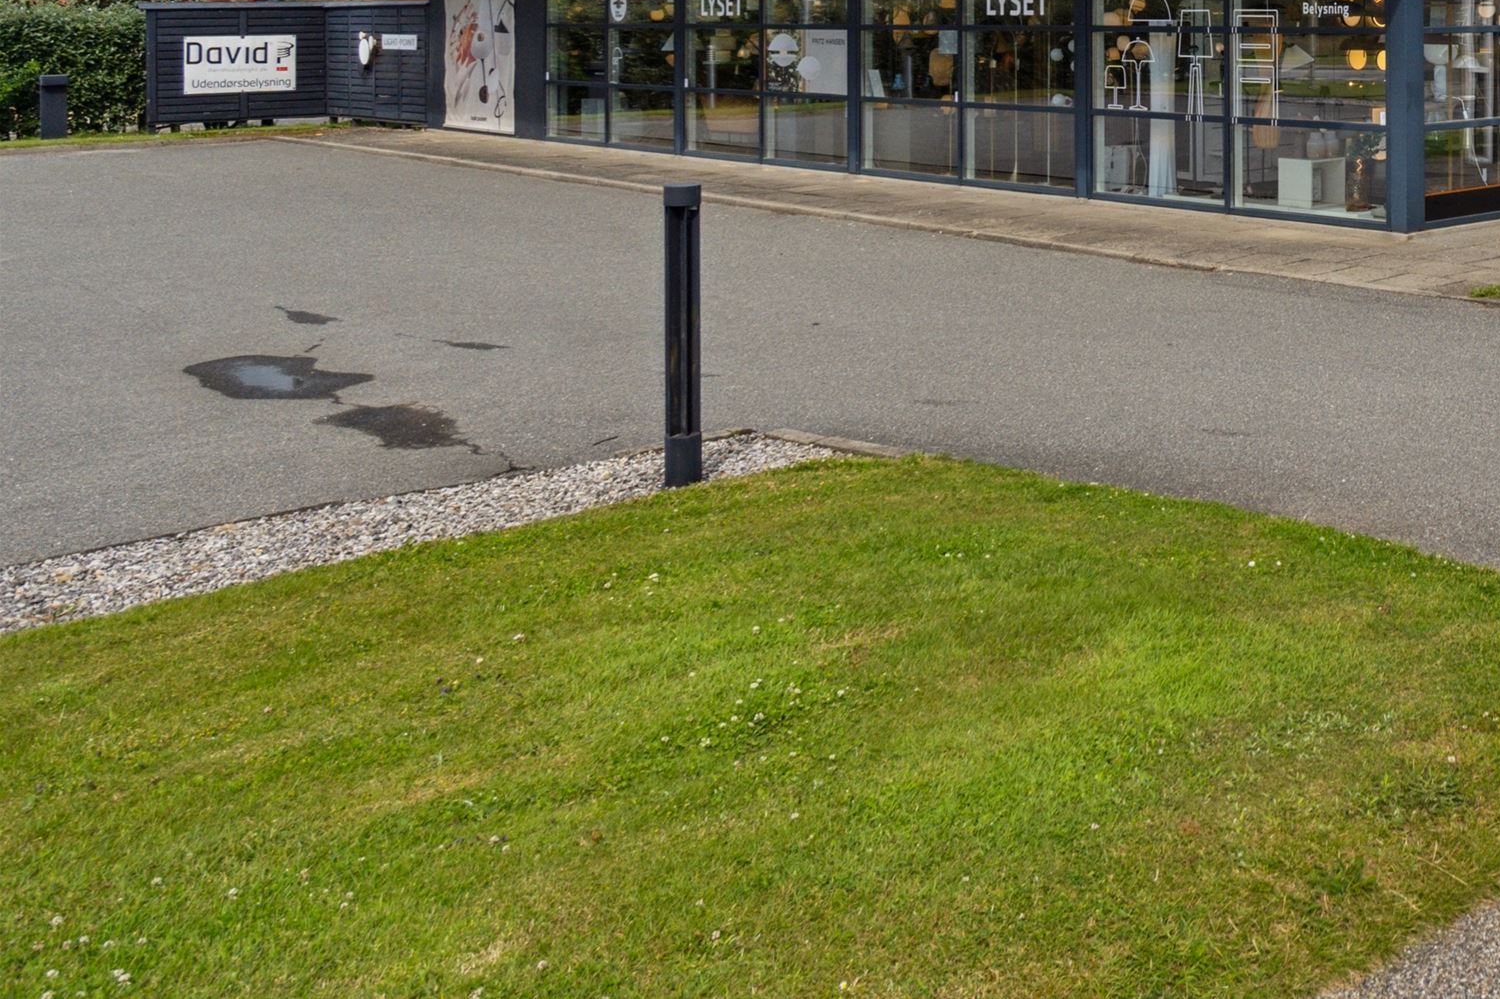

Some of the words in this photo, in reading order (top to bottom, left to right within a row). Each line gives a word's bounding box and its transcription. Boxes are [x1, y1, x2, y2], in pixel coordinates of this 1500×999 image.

[1302, 2, 1350, 18] Belysning
[186, 42, 268, 65] David
[191, 78, 292, 88] Udendørsbelysning
